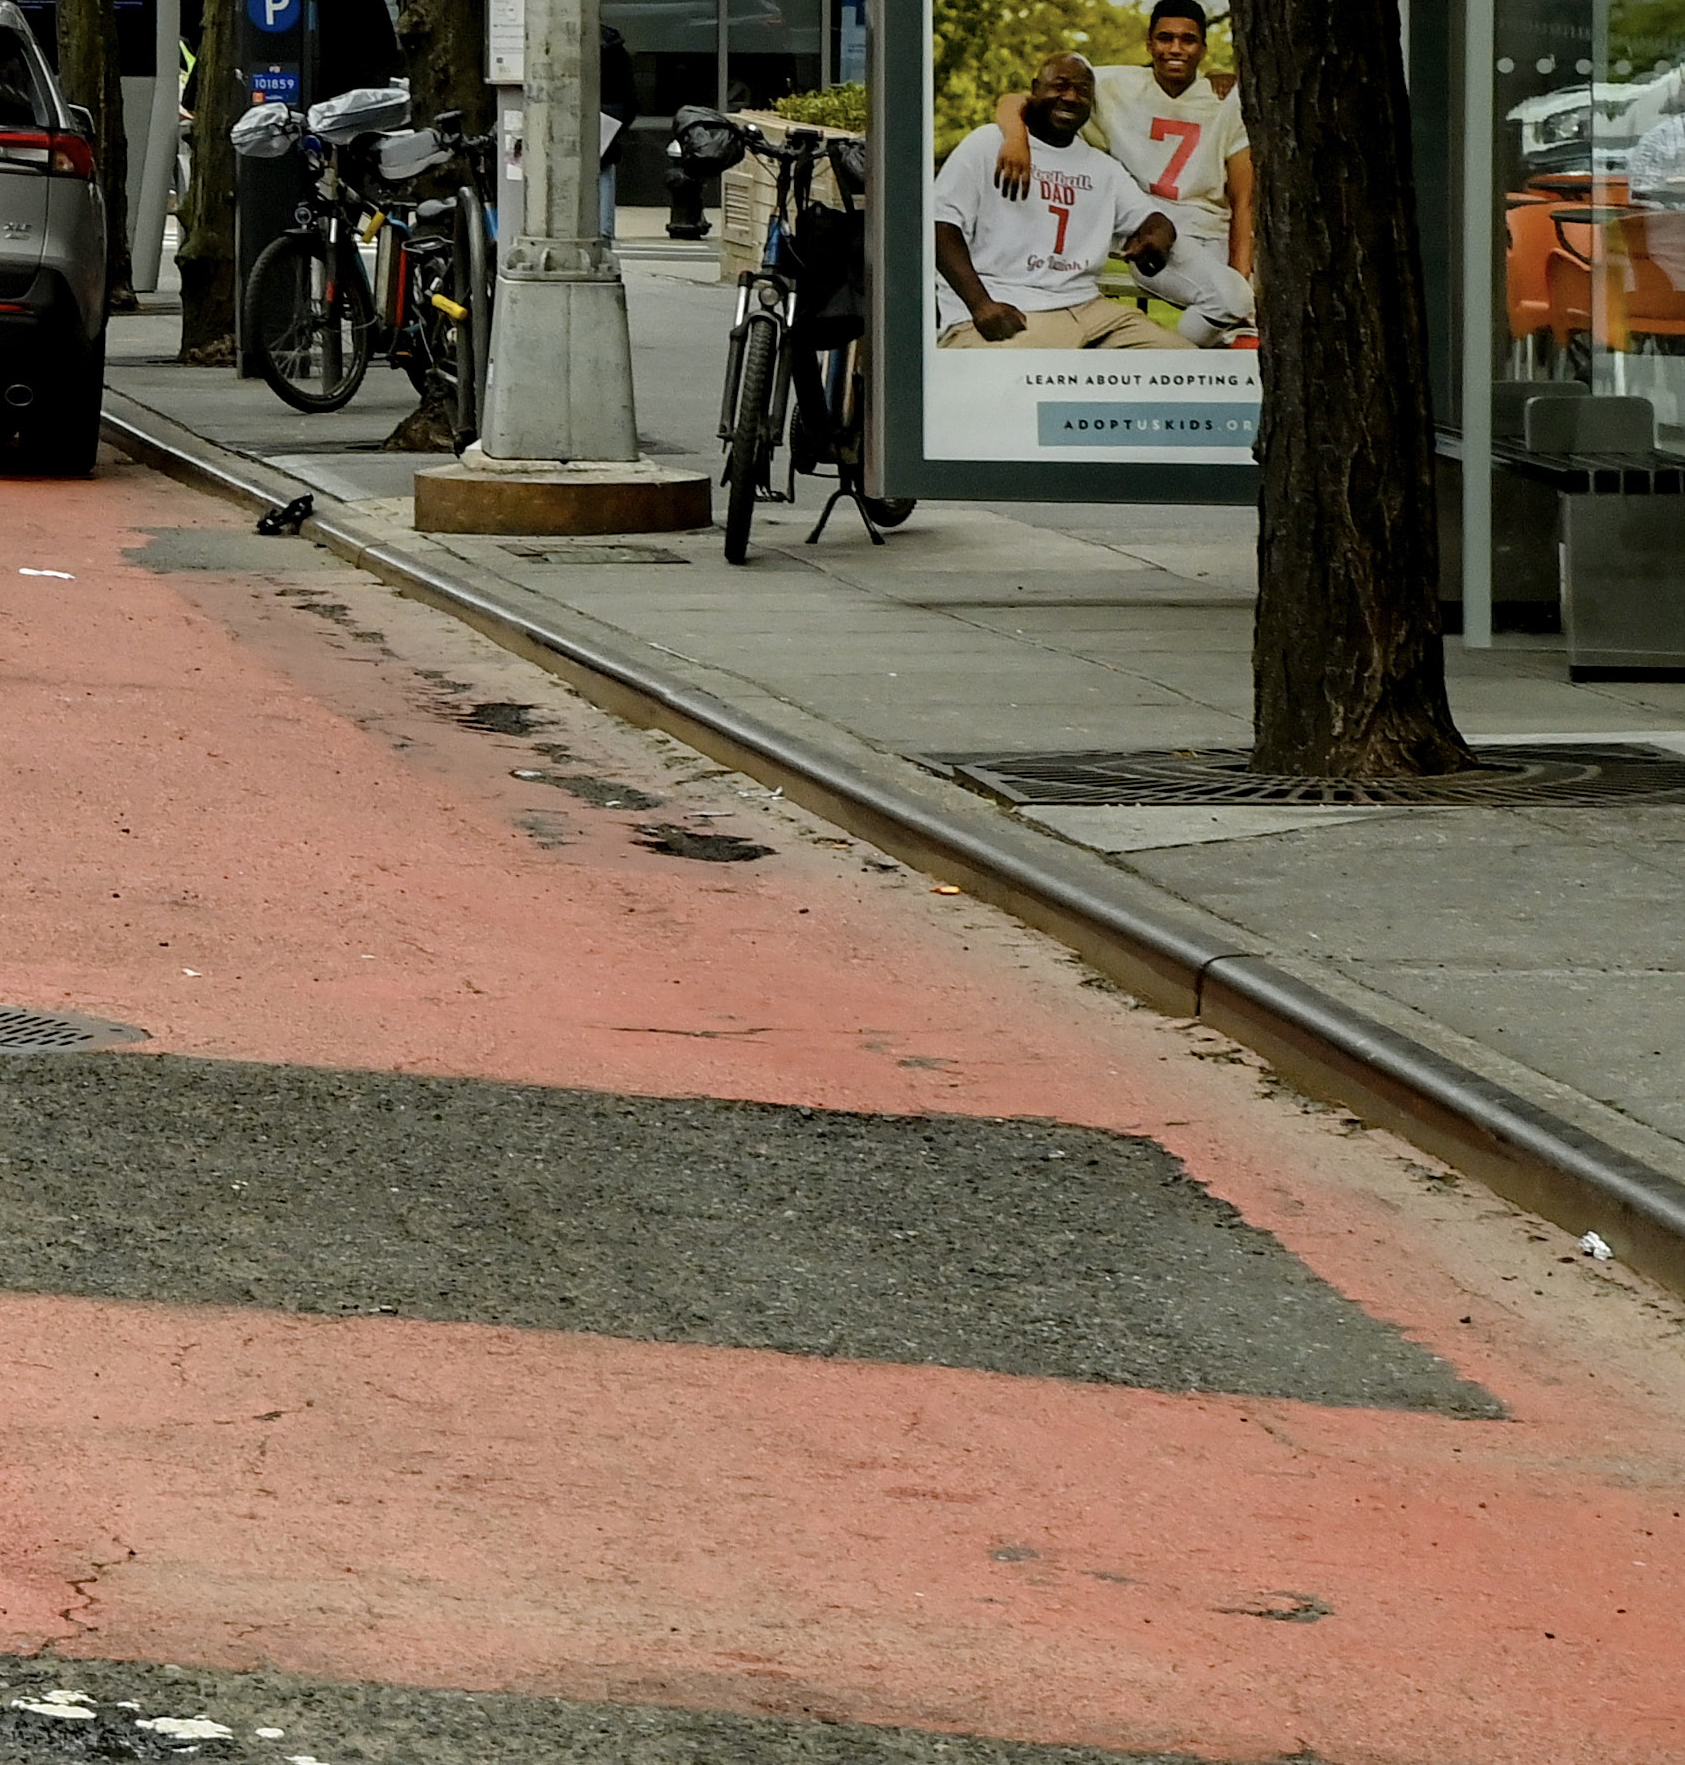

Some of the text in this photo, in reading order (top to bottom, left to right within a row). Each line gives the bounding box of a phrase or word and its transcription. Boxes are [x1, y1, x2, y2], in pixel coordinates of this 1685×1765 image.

[254, 79, 295, 90] 101859
[1149, 117, 1202, 201] 7
[1040, 180, 1076, 206] DAD
[1048, 204, 1070, 255] 7
[1026, 373, 1256, 387] LEARN ABOUT ADOPTING A
